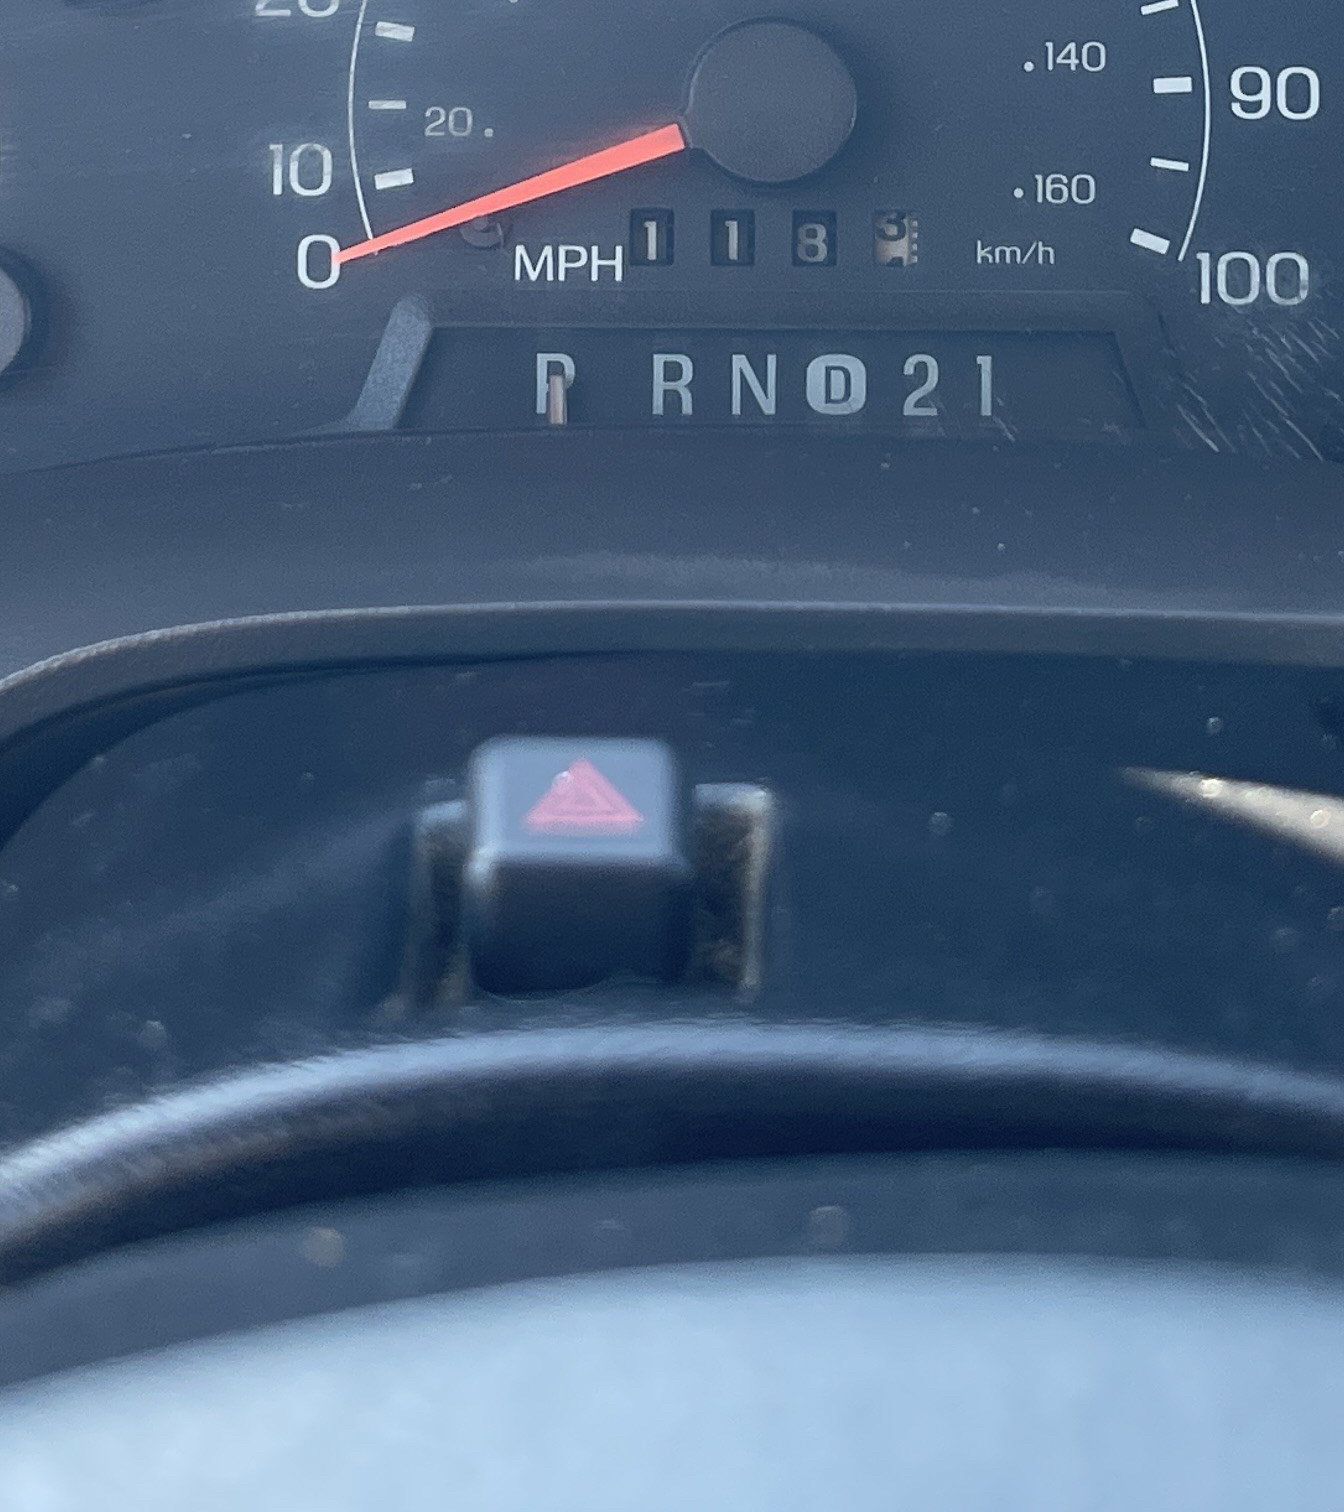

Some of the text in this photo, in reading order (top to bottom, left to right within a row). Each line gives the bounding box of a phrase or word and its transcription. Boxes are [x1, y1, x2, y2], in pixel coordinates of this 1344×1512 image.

[1045, 41, 1106, 72] 140
[1230, 66, 1320, 120] 90
[424, 106, 473, 137] 20
[269, 143, 332, 197] 10
[1035, 173, 1096, 205] 160
[297, 234, 341, 289] 0
[514, 244, 623, 282] MPH
[976, 240, 1055, 265] km/h
[1196, 251, 1309, 306] 100
[536, 352, 992, 417] P R N D 2 1
